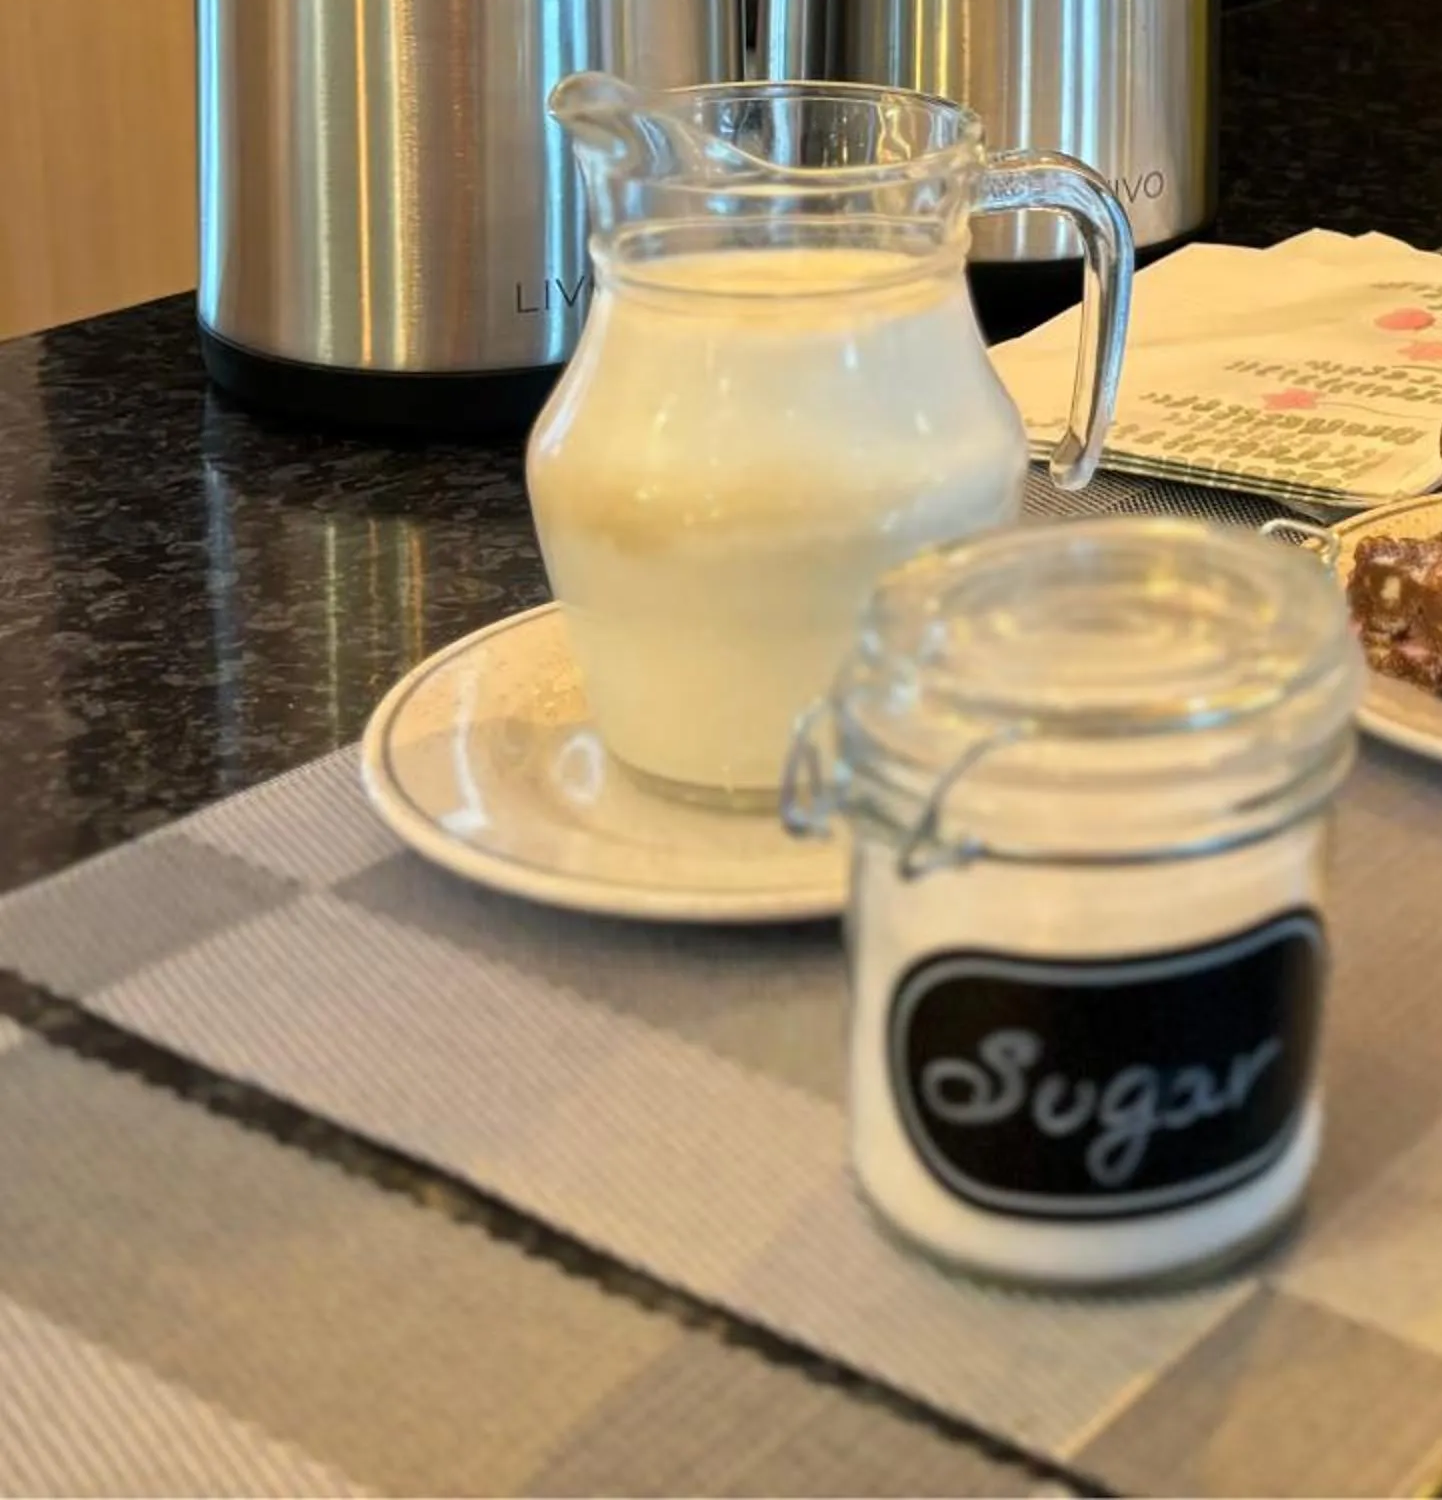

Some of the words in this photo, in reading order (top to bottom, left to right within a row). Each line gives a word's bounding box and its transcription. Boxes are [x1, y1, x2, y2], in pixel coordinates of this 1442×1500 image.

[1111, 171, 1165, 203] IVO
[515, 275, 592, 314] LIV
[921, 1026, 1283, 1186] Sugar
